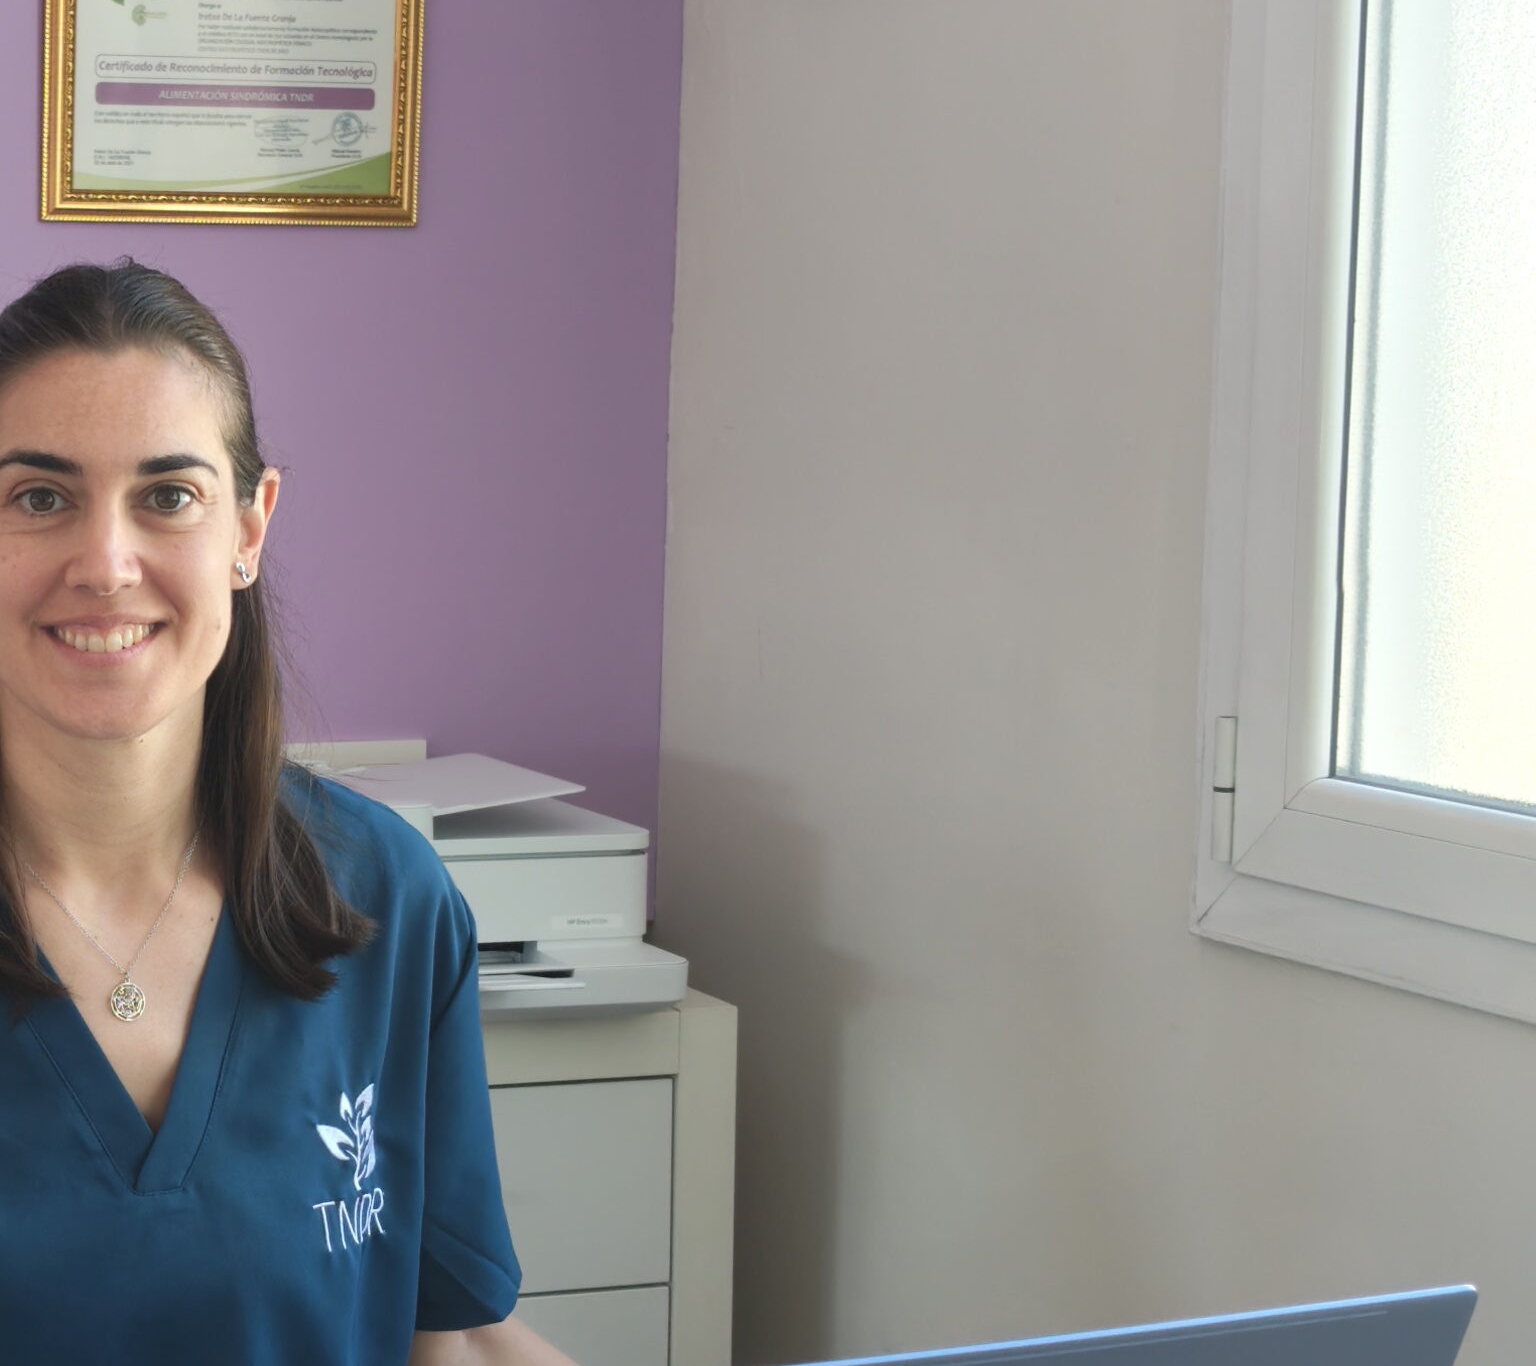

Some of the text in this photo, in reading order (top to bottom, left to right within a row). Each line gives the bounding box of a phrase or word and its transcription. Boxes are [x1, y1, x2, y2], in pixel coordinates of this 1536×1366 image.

[99, 61, 373, 80] Certificado de Reconocimiento de Formación Tecnológica
[159, 90, 314, 102] ALIMENTACIÓN SINDRÓMICA TNDR
[313, 1187, 386, 1252] TNDR
